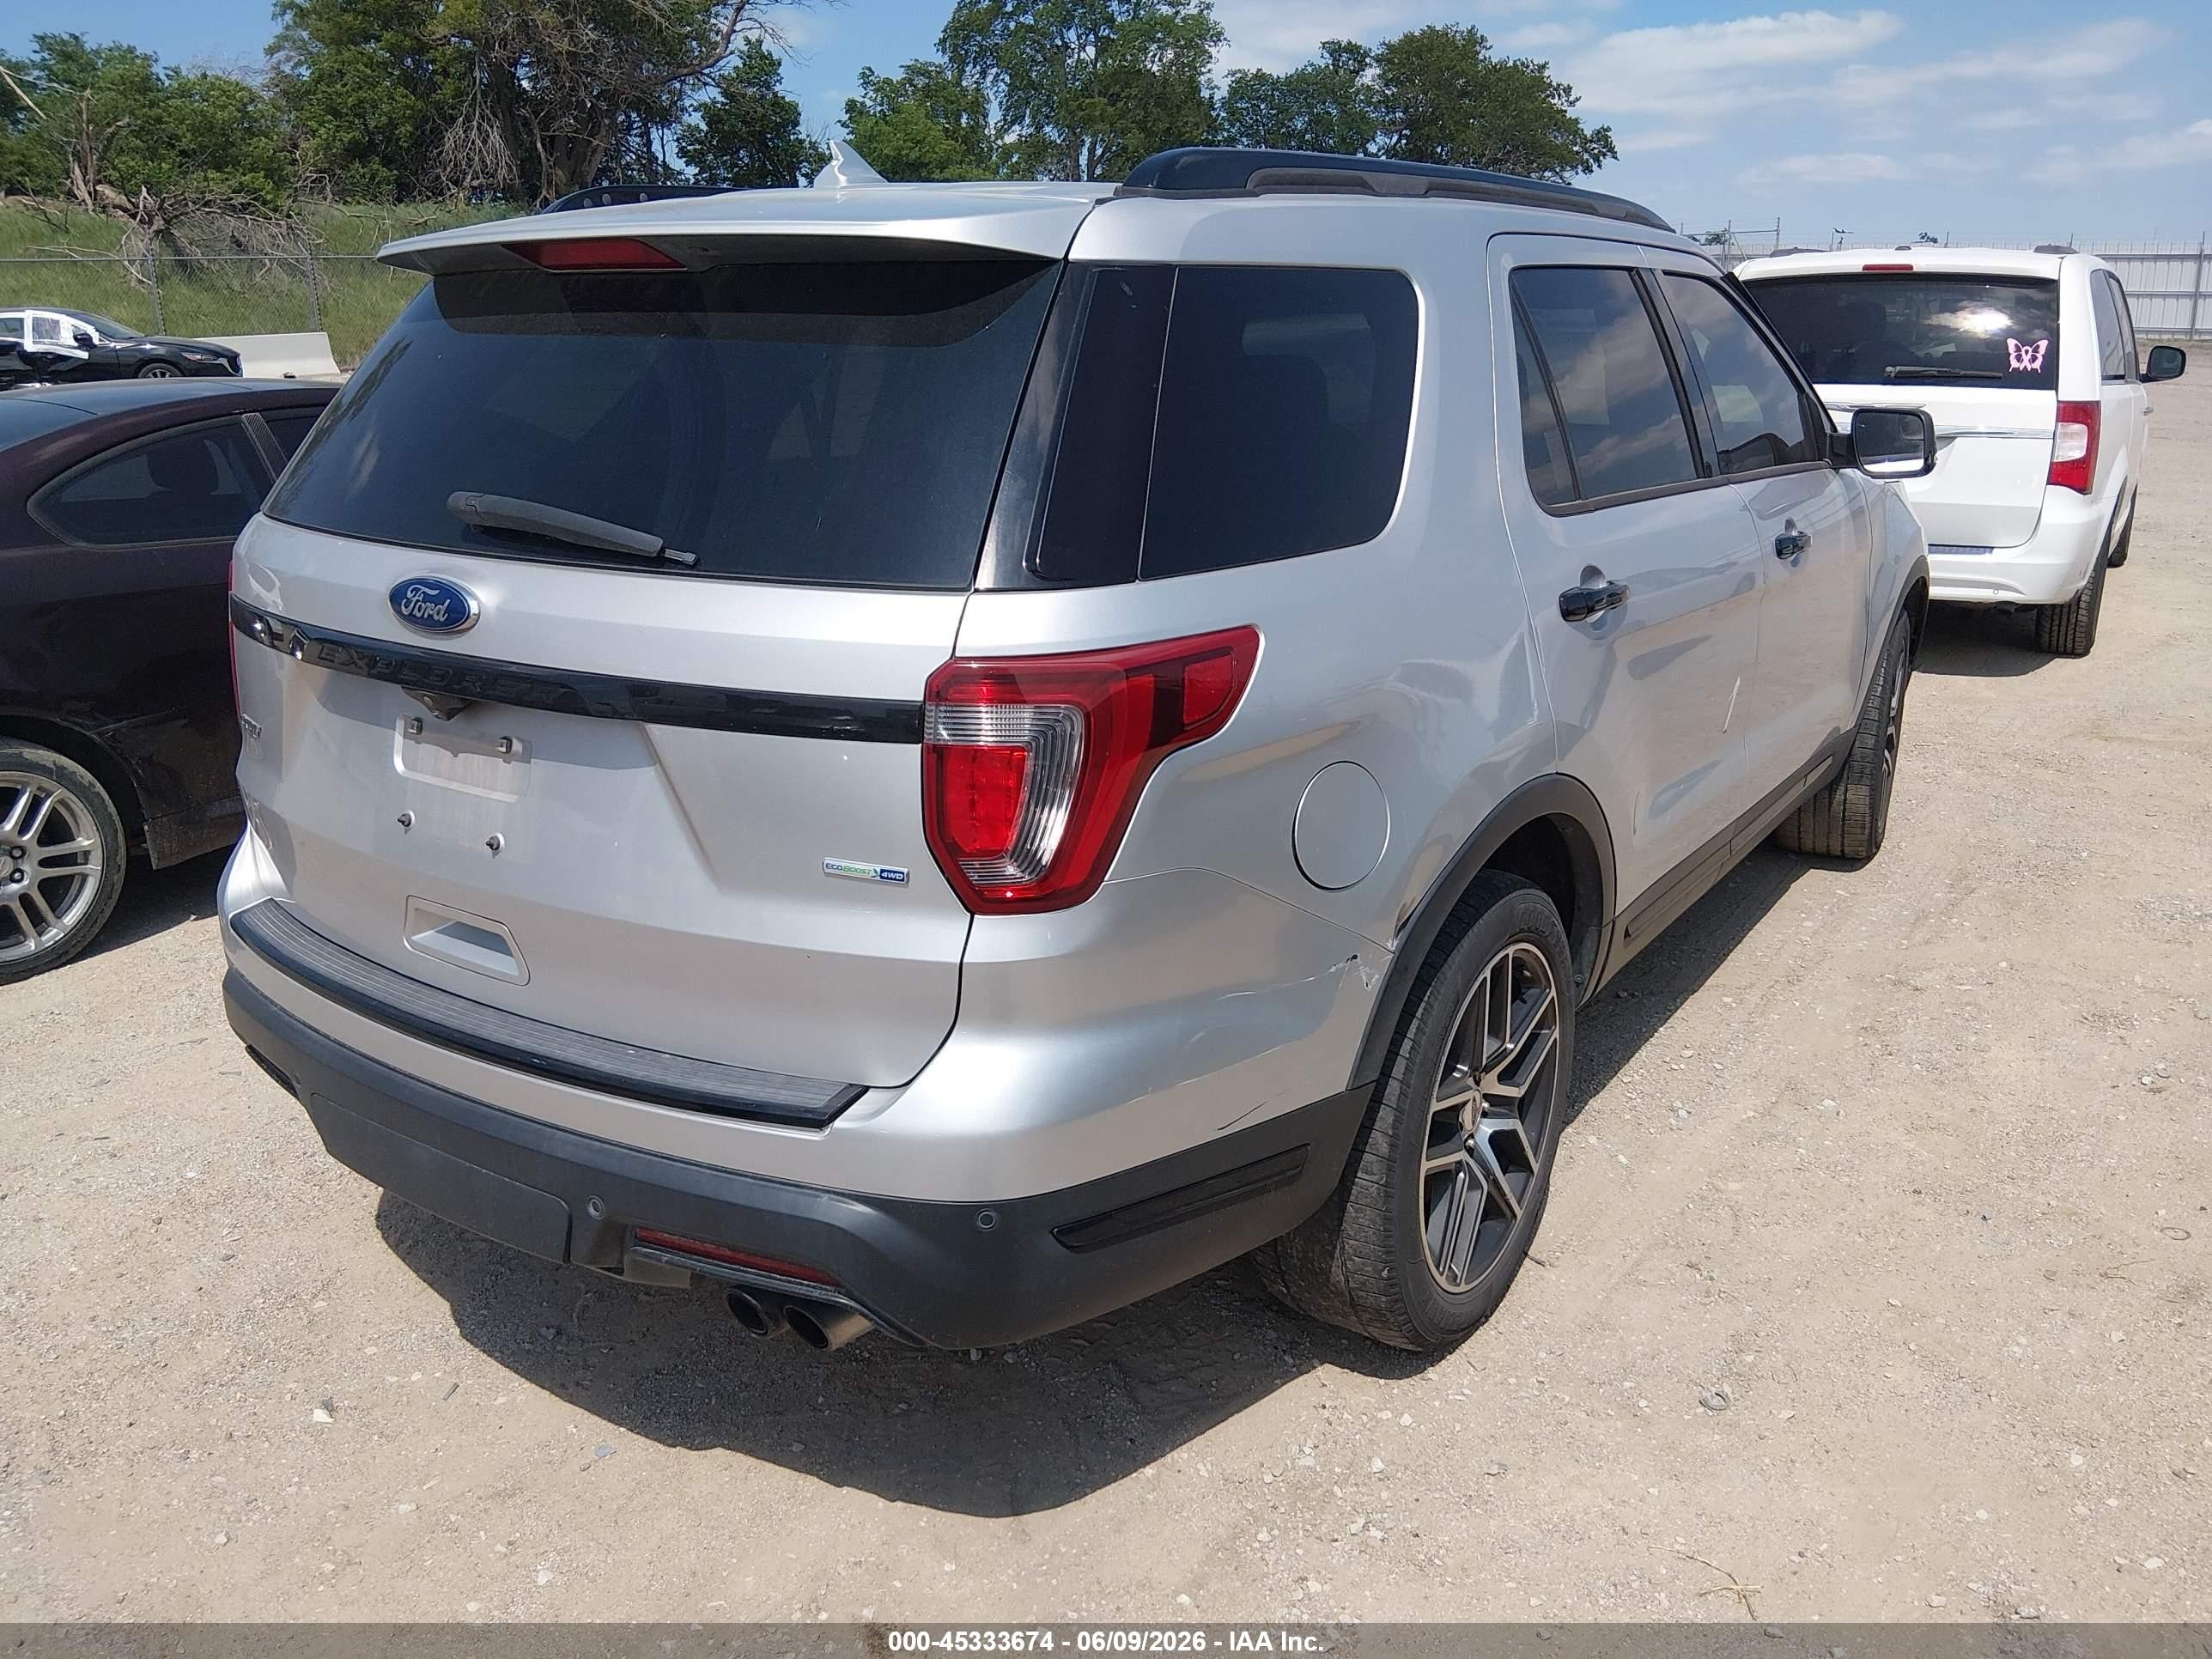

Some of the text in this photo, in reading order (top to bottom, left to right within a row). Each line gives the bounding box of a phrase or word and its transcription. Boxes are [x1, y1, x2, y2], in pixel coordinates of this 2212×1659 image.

[401, 584, 451, 622] Ford
[825, 862, 904, 880] ECOBOOST 4WD
